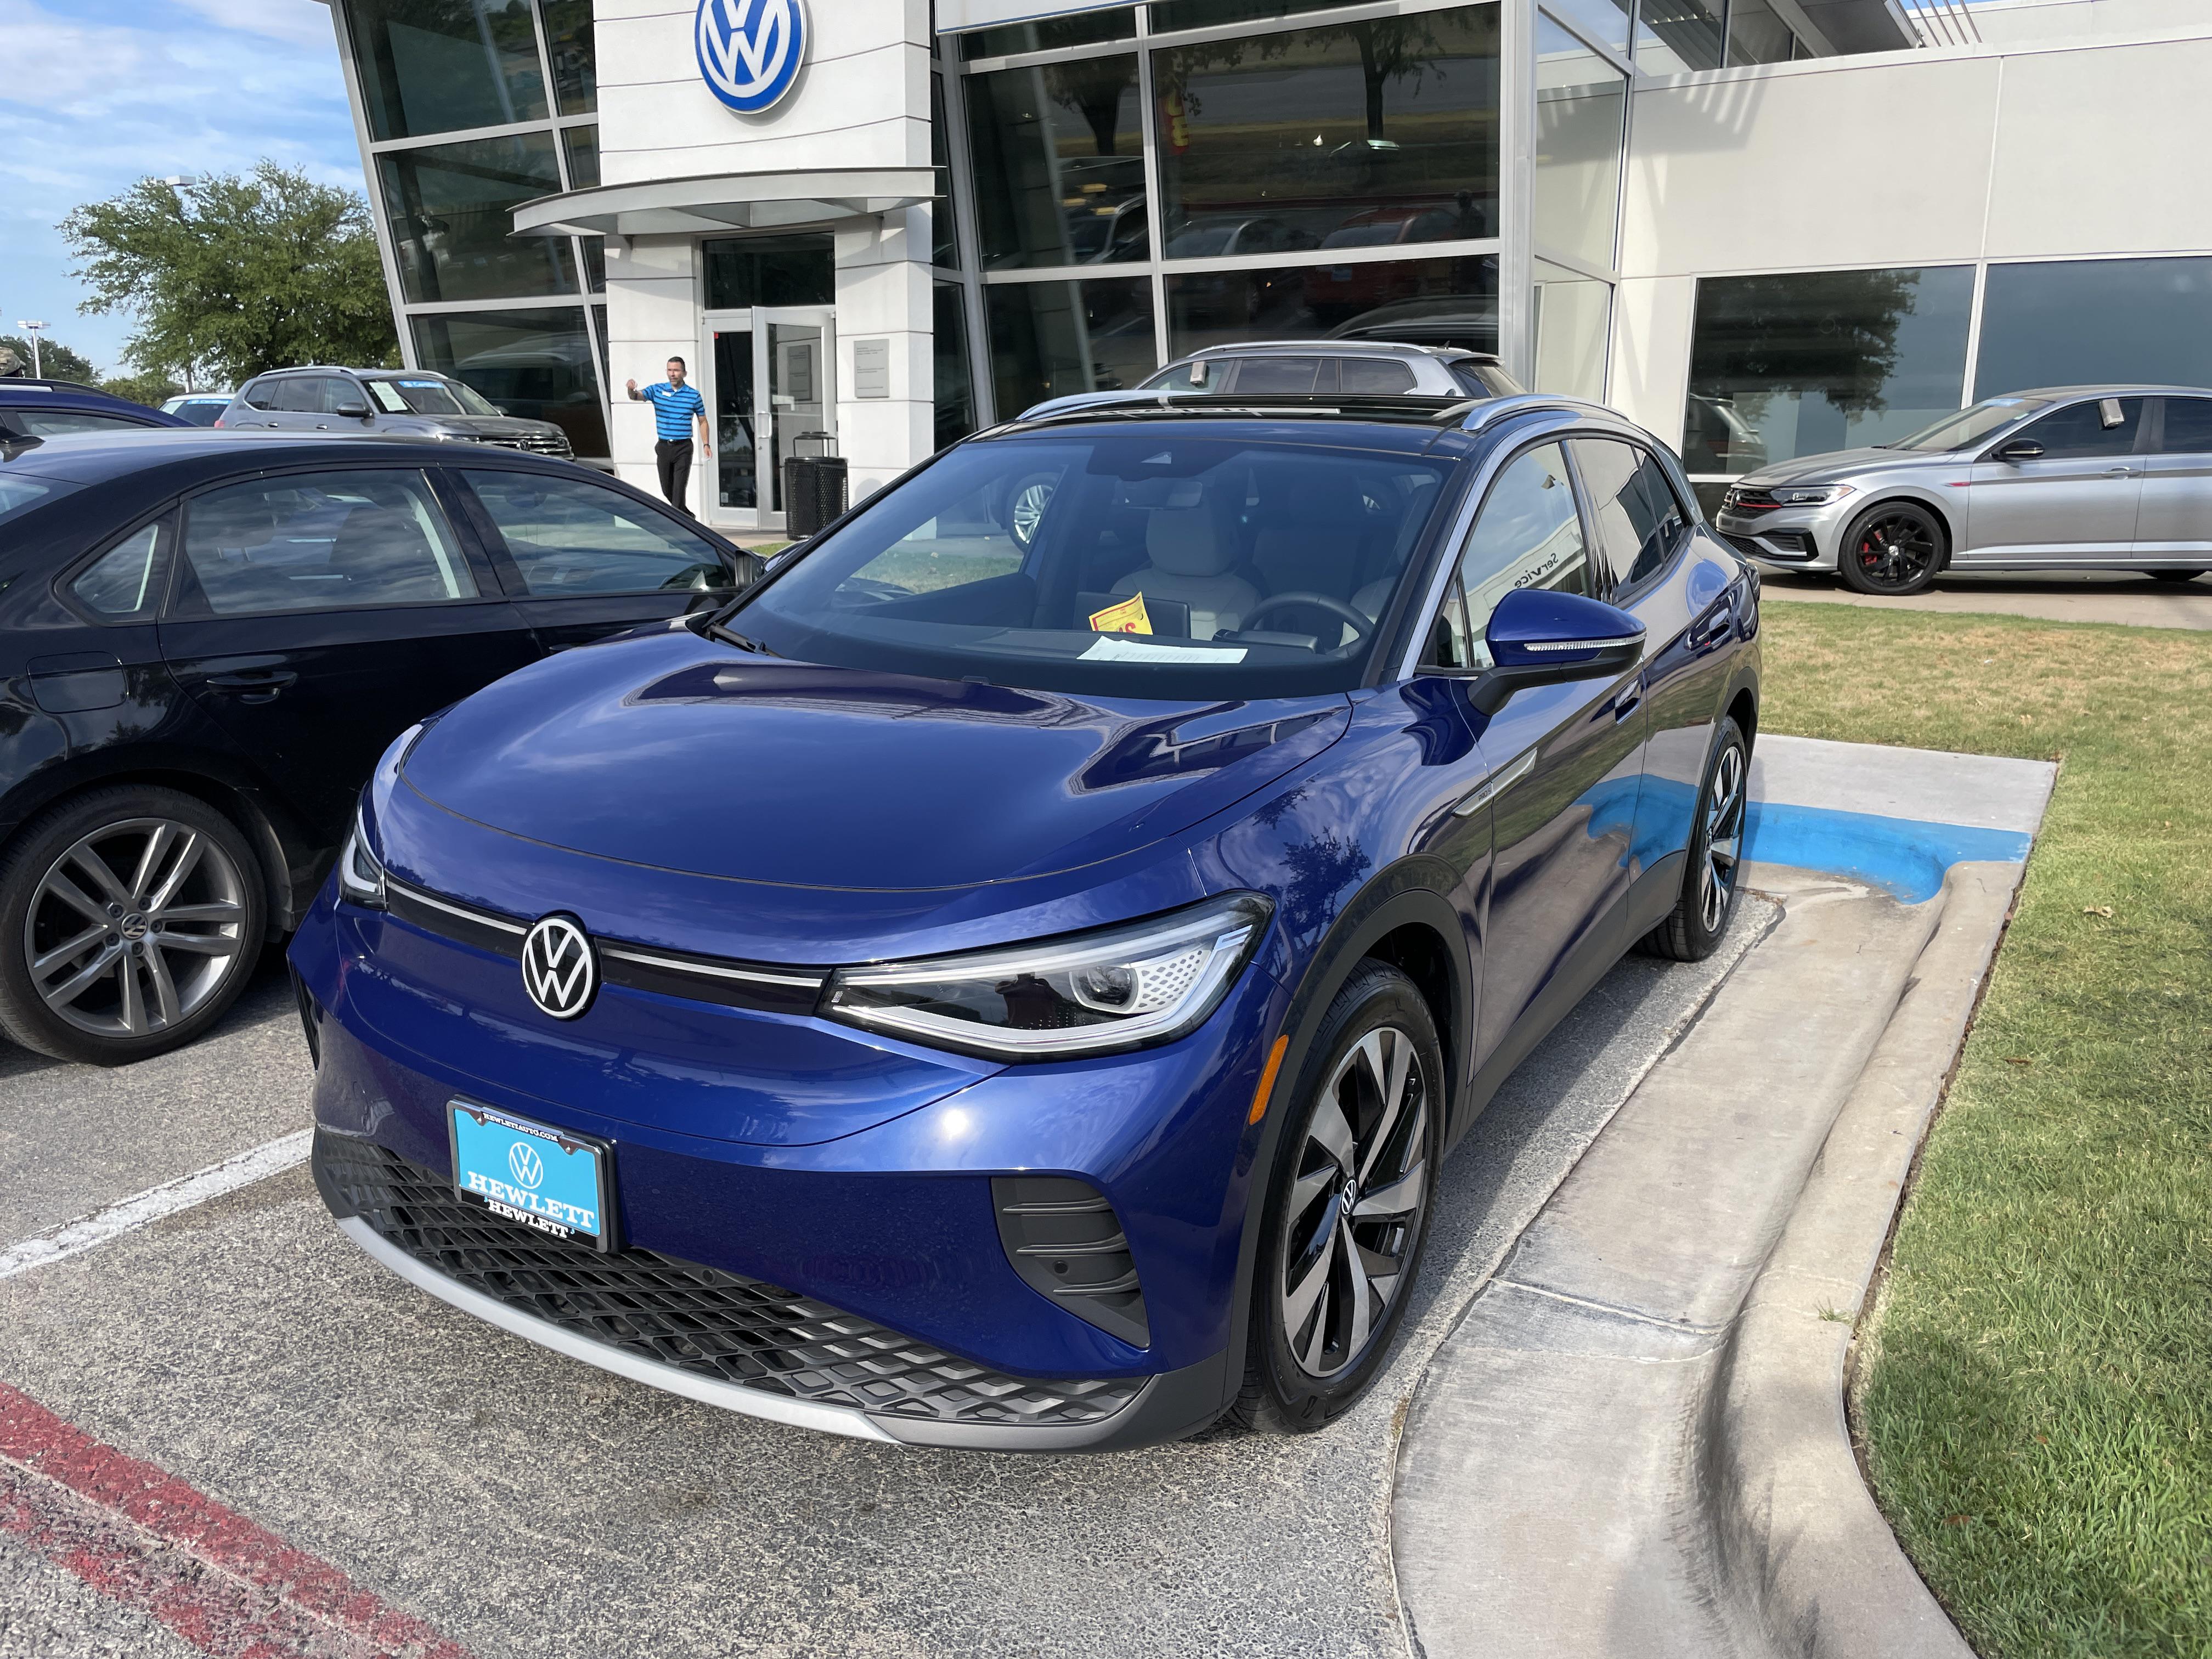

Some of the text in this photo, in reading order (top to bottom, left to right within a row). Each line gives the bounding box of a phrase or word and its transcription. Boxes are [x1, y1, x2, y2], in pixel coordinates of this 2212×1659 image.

[524, 922, 590, 1013] VW
[483, 1113, 558, 1142] HEWLETTAUTO.COM
[510, 1142, 543, 1188] VW
[468, 1171, 594, 1228] HEWLETT
[488, 1199, 568, 1238] HEWLETT
